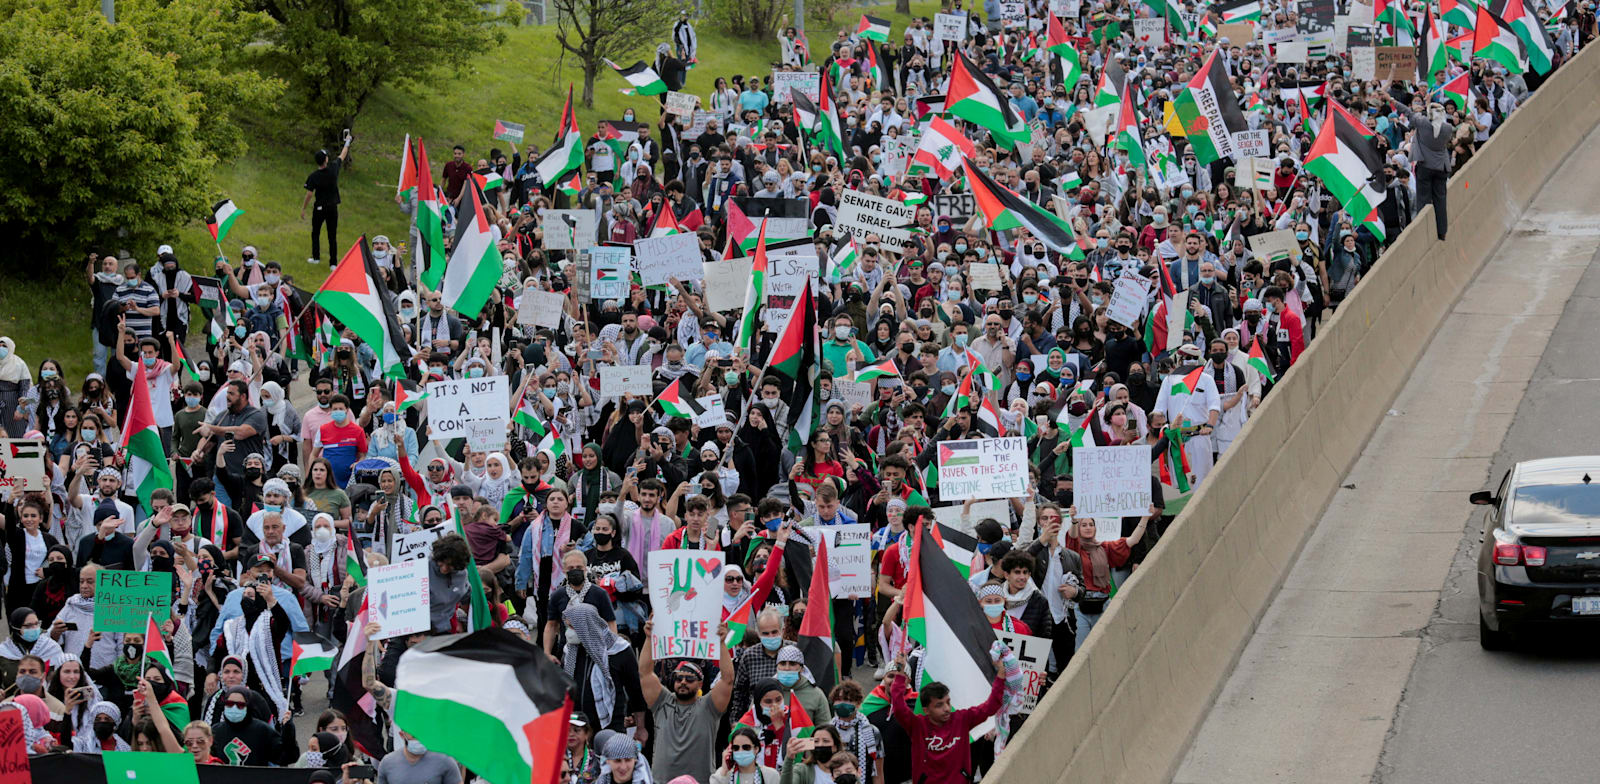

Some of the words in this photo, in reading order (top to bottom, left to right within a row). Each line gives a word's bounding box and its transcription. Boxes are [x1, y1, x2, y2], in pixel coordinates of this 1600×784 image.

[1199, 88, 1212, 110] FREE
[1207, 109, 1232, 156] PALESTINE
[1250, 131, 1261, 139] THE
[1237, 141, 1253, 149] SEIGE
[1243, 148, 1259, 156] GAZA
[843, 194, 884, 212] SENATE
[885, 204, 913, 219] GAVE
[856, 212, 892, 230] ISRAEL
[635, 239, 666, 257] THIS
[594, 252, 625, 265] FREE
[769, 259, 782, 278] I
[434, 384, 459, 398] IT'S
[471, 381, 496, 394] NOT
[458, 402, 470, 416] A
[470, 425, 494, 438] YEMEN
[982, 439, 1023, 453] FROM
[993, 454, 1011, 463] THE
[1078, 451, 1096, 465] THE
[942, 467, 967, 478] RIVER
[970, 466, 979, 475] TO
[979, 465, 995, 476] THE
[998, 463, 1019, 473] SEA
[1079, 493, 1106, 513] ALLAH
[401, 561, 415, 569] the
[101, 573, 161, 588] FREE
[377, 573, 415, 584] RESISTANCE
[390, 591, 418, 600] REFUSAL
[421, 577, 429, 606] RIVER
[97, 591, 168, 607] PALESTINE
[391, 607, 417, 616] RETURN
[674, 619, 709, 639] FREE
[653, 634, 716, 659] PALESTINE
